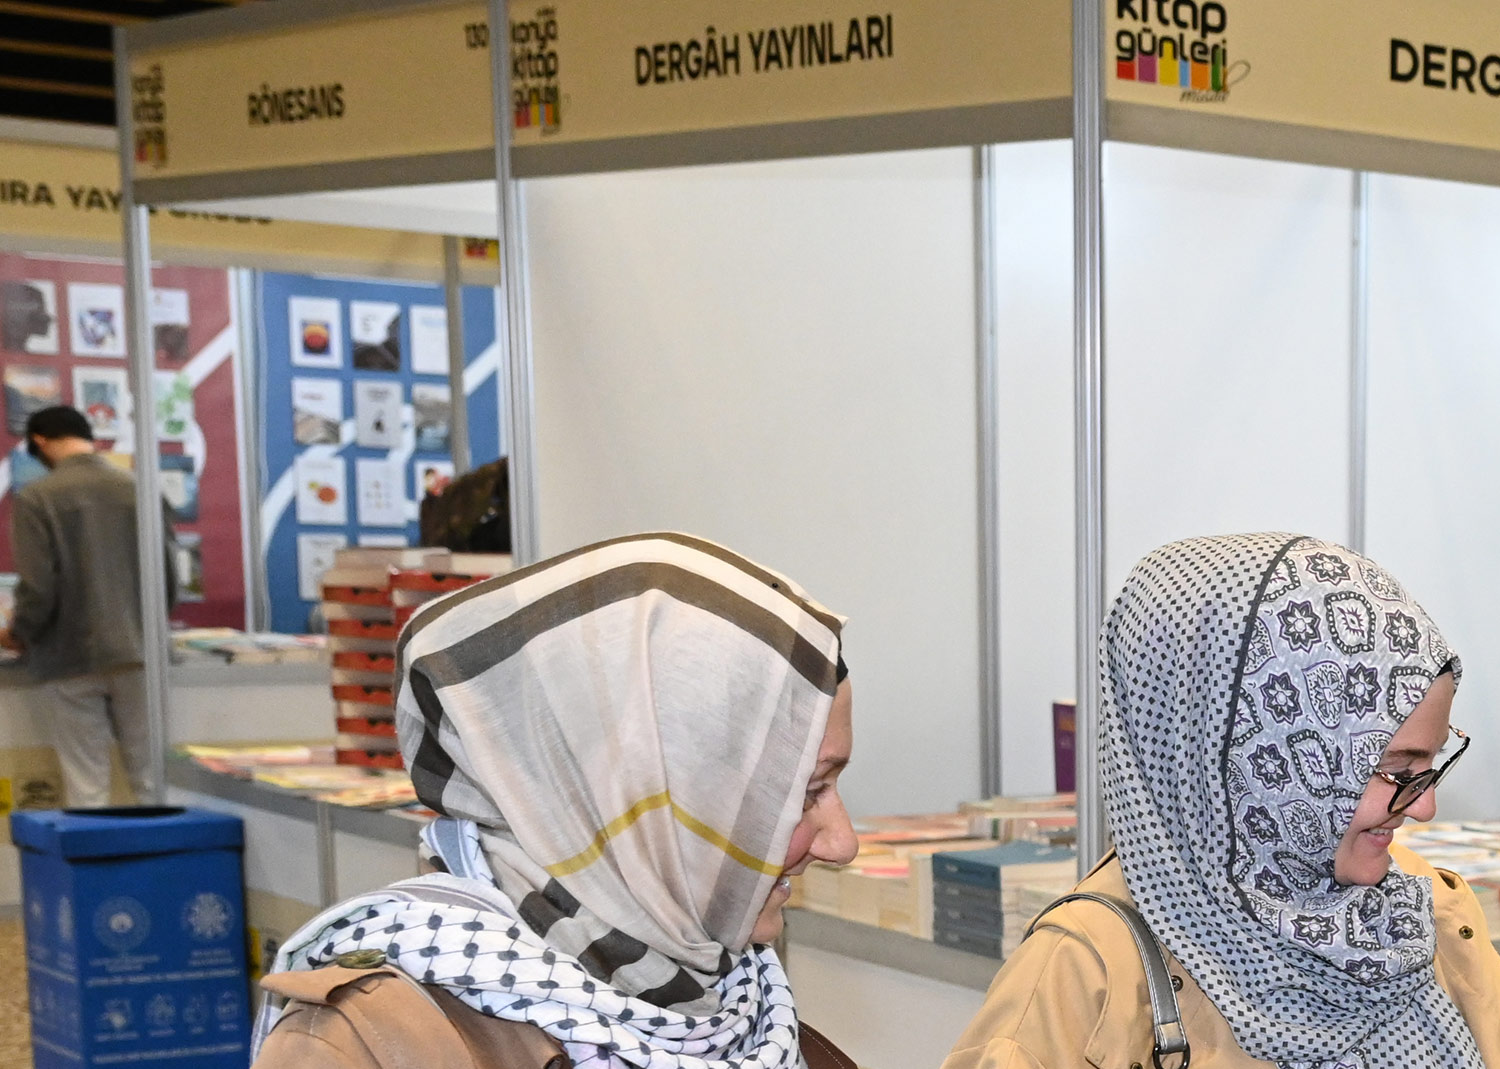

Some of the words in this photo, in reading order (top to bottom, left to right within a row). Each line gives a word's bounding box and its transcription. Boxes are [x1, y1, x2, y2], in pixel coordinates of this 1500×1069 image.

[635, 26, 740, 86] DERGÂH
[747, 13, 893, 74] YAYINLARI
[1116, 26, 1227, 67] günleri
[247, 81, 344, 126] RÖNESANS
